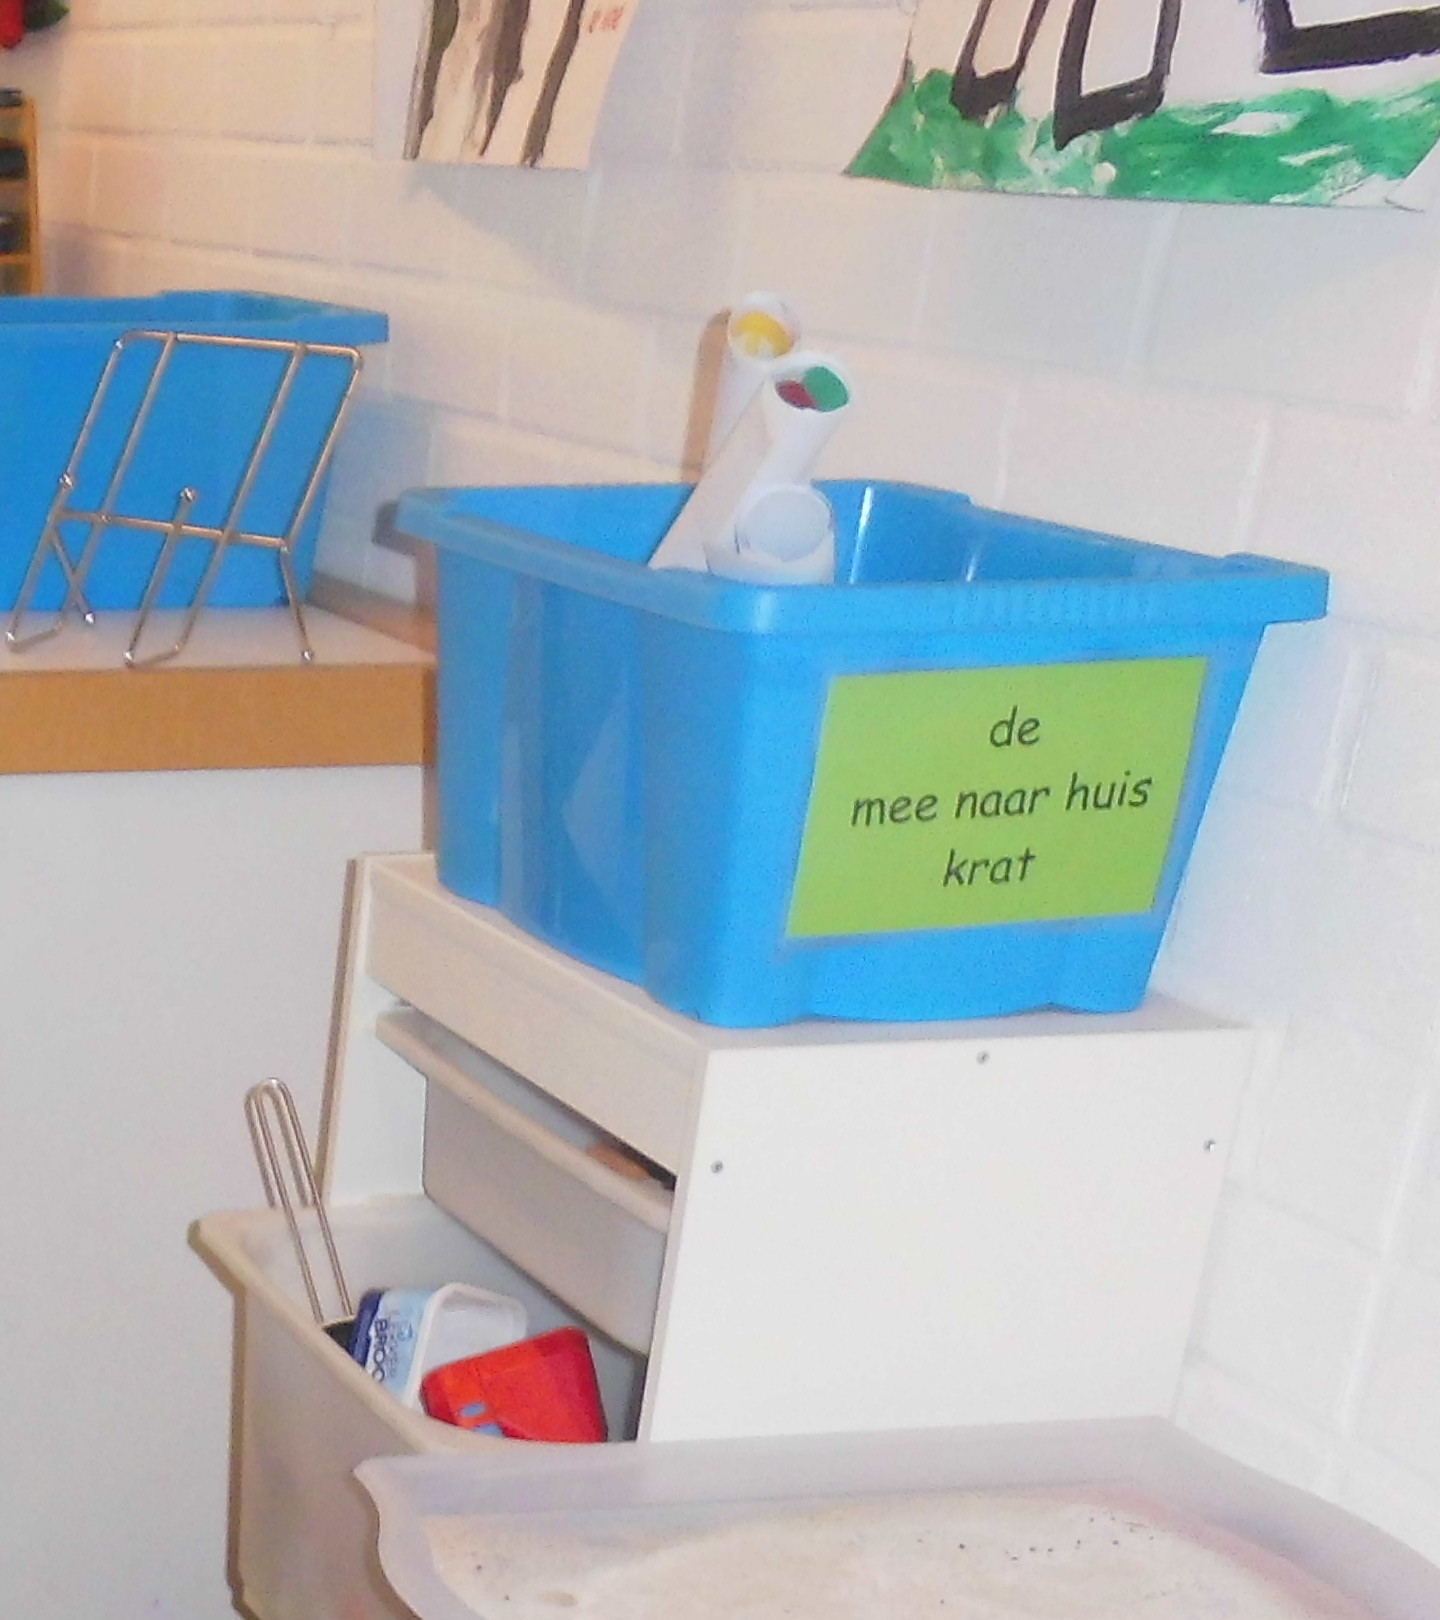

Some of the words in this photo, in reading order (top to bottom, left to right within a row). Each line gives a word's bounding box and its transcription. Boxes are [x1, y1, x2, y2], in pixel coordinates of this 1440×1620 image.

[989, 705, 1041, 748] de
[850, 793, 939, 827] mee
[954, 785, 1050, 819] naar
[1065, 770, 1153, 811] huis
[942, 847, 1037, 888] krat
